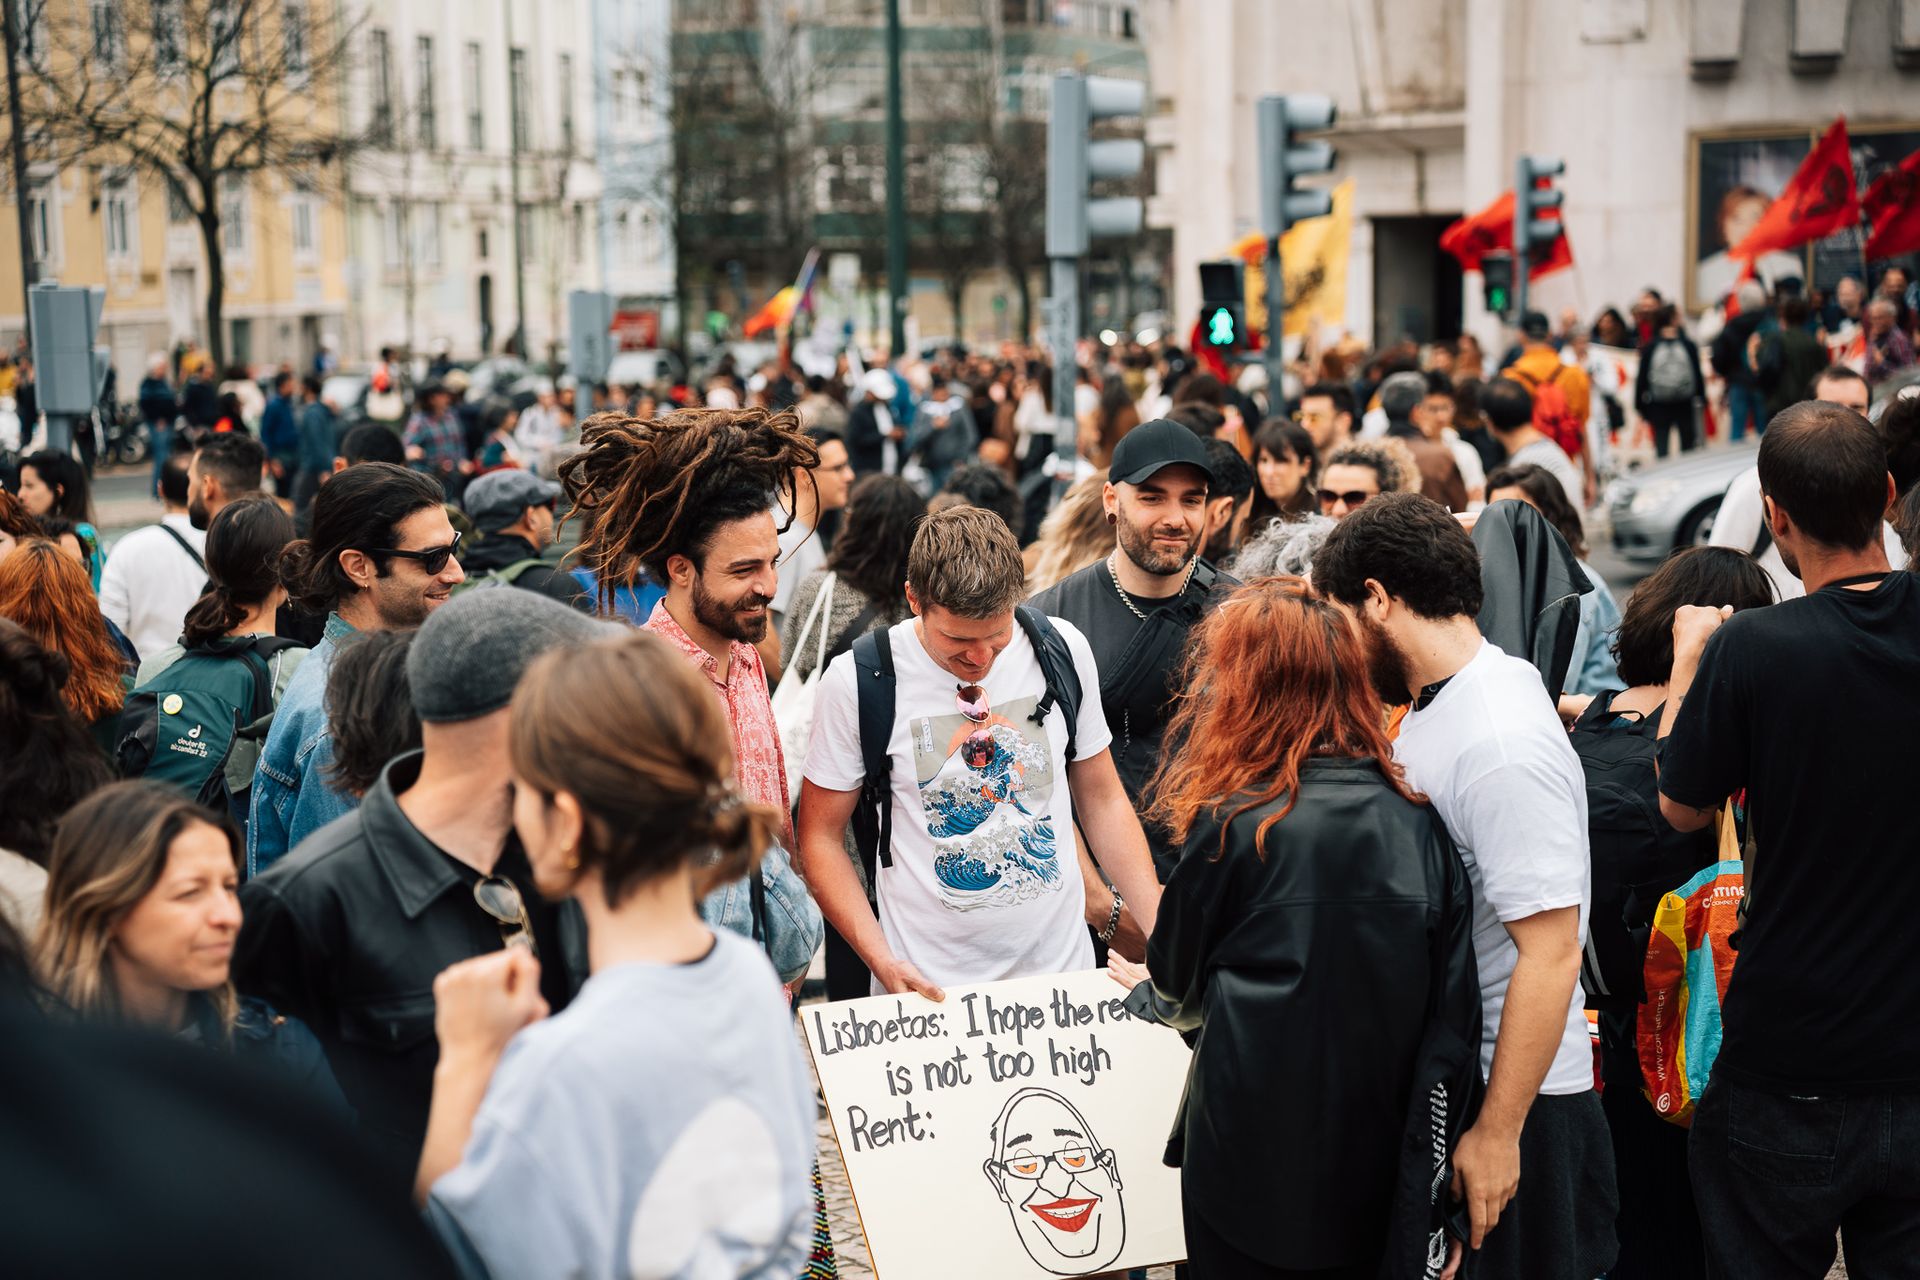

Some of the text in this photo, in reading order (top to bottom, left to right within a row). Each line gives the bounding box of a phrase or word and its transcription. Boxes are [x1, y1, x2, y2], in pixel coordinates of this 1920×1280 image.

[814, 1000, 949, 1056] Lisboetas:
[961, 992, 984, 1038] I
[985, 995, 1046, 1045] hope
[1049, 988, 1094, 1028] the
[885, 1034, 1112, 1096] is not too high
[847, 1100, 936, 1152] Rent:
